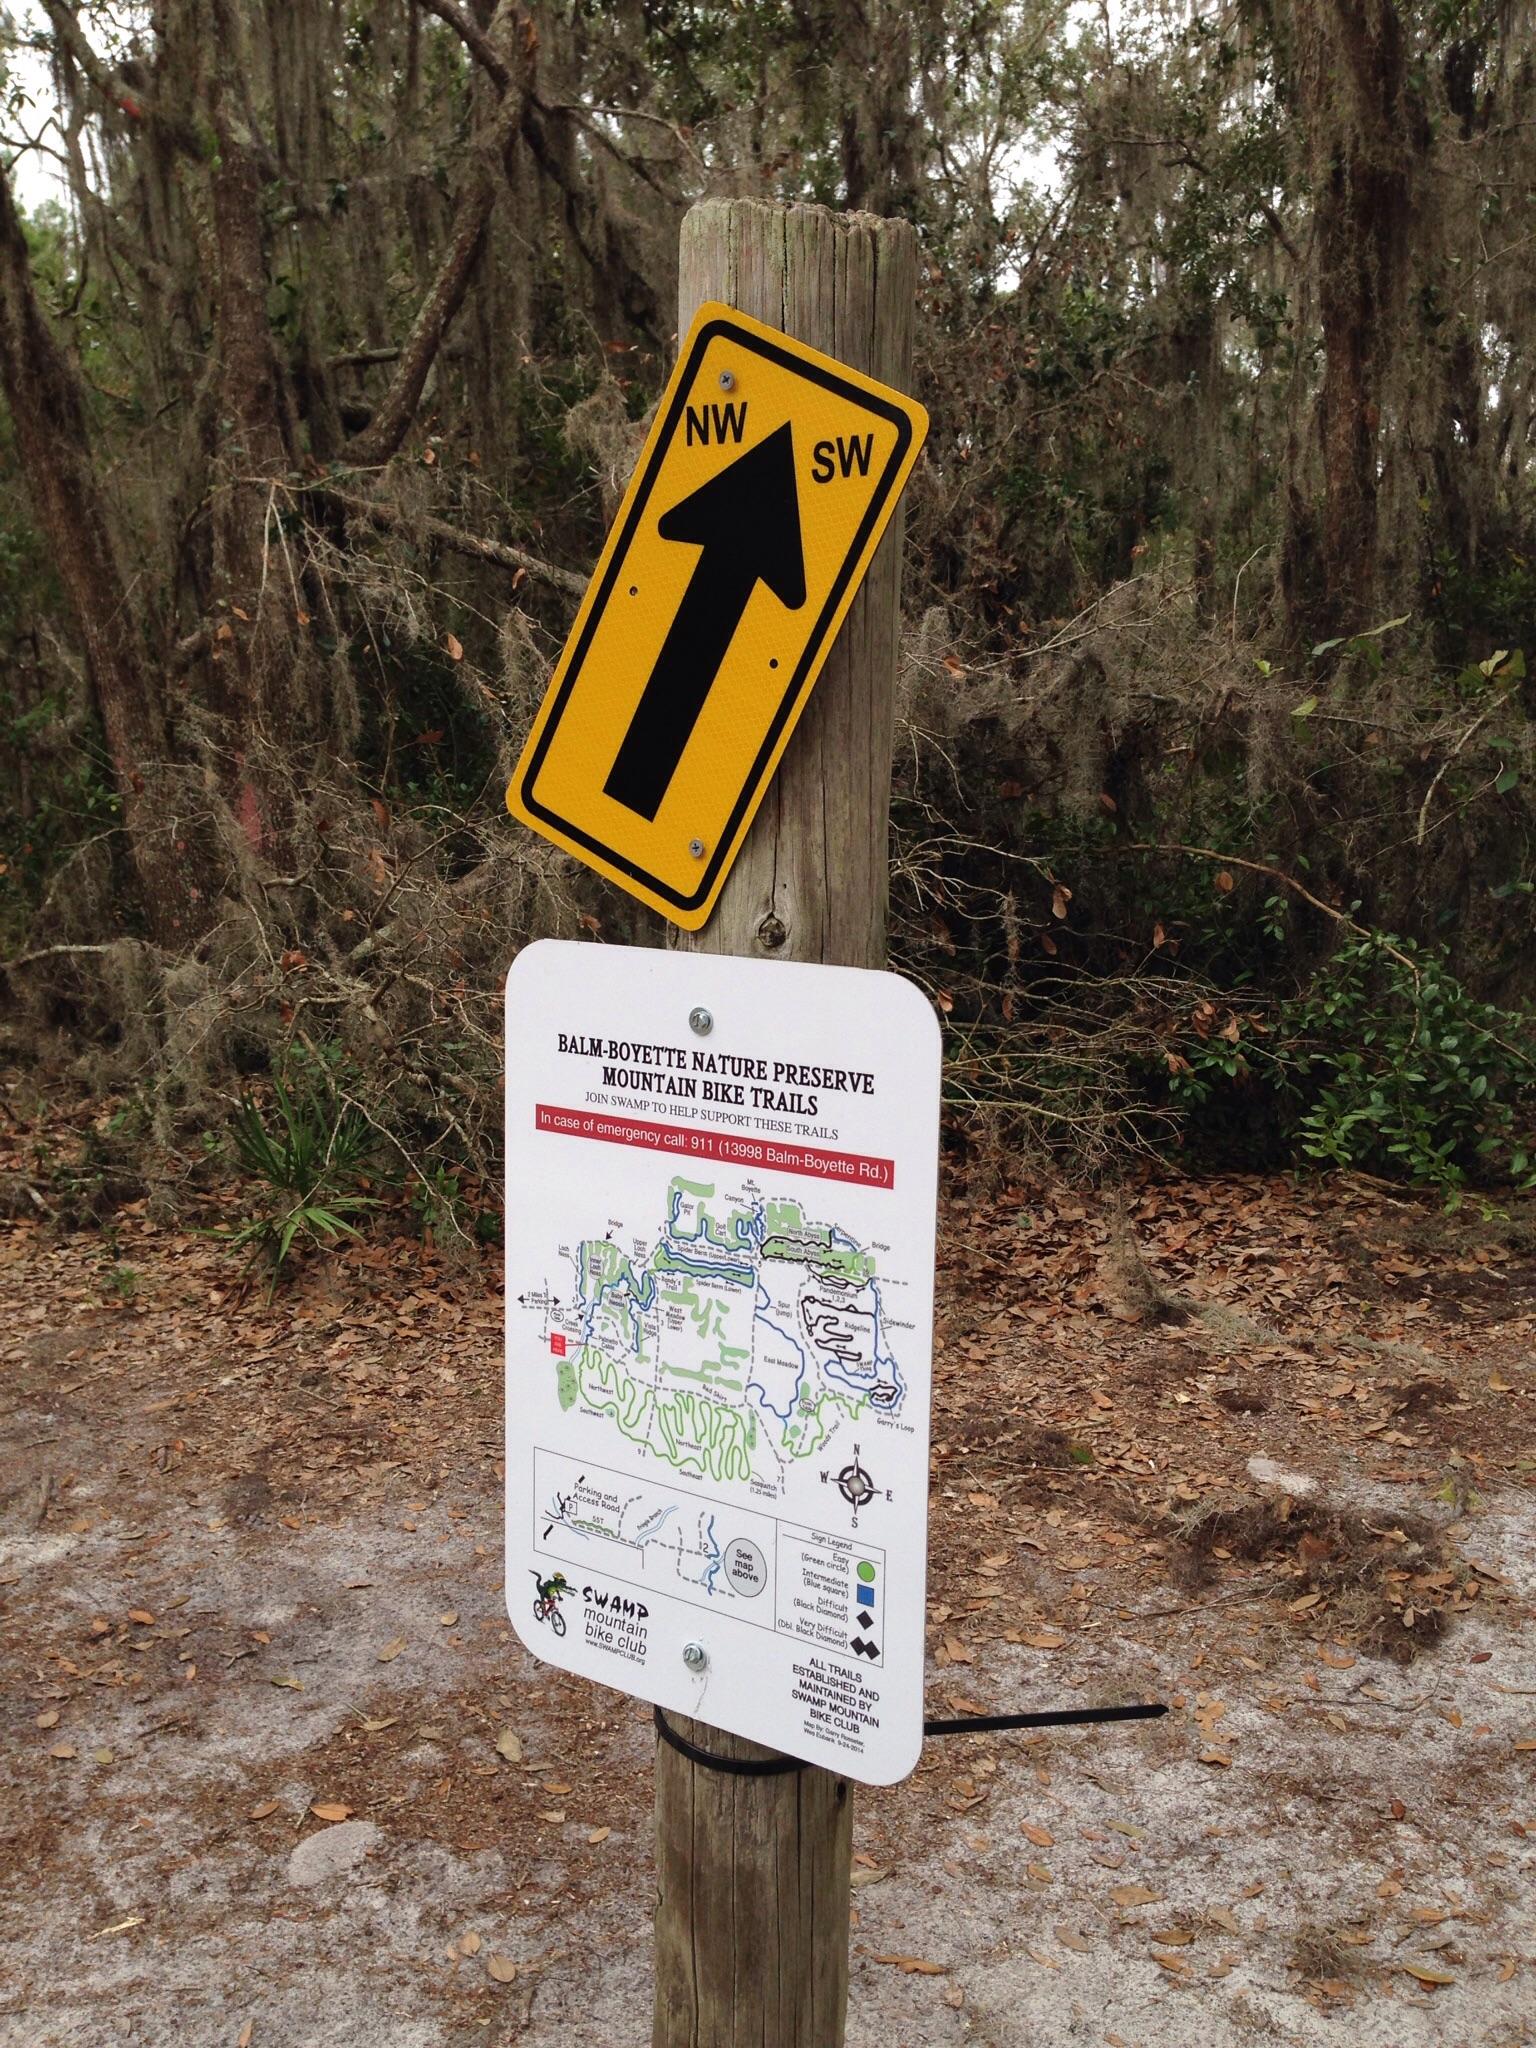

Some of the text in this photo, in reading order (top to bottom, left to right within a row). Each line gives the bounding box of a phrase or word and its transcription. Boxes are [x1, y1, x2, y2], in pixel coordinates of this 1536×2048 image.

[686, 402, 748, 446] NW
[811, 433, 874, 484] SW
[558, 1033, 874, 1095] BALM-BOYETTE NATURE PRESERVE
[603, 1066, 818, 1116] MOUNTAIN BIKE TRAILS
[585, 1091, 839, 1140] JOIN SWAMP TO HELP SUPPORT THESE TRAILS
[541, 1110, 888, 1183] In case of emergency call: 911 (13998 Balm-Boyette Rd.)
[872, 1242, 890, 1252] Bridge
[844, 1322, 871, 1333] Ridgeline
[882, 1317, 916, 1330] Sidewinder
[853, 1443, 860, 1456] N
[819, 1470, 830, 1484] W
[572, 1492, 621, 1513] Access Road
[573, 1482, 618, 1503] Parking and
[886, 1489, 893, 1502] E
[851, 1516, 858, 1529] S
[702, 1542, 709, 1554] 2
[811, 1532, 853, 1551] Sign Legend
[734, 1560, 754, 1572] map
[736, 1548, 753, 1562] See
[801, 1551, 850, 1575] (Green circle)
[832, 1552, 850, 1566] Easy
[732, 1567, 759, 1583] above
[802, 1568, 849, 1589] Intermediate
[803, 1578, 849, 1599] (Blue square)
[582, 1585, 649, 1621] SWAMP
[793, 1597, 849, 1624] (Black Diamond)
[817, 1596, 848, 1613] Difficult
[583, 1607, 648, 1639] mountain
[799, 1617, 848, 1639] Very Difficult
[585, 1621, 647, 1656] bike club
[795, 1624, 815, 1637] Black
[815, 1629, 848, 1649] Diamond)
[585, 1638, 646, 1666] www.SWAMPCLUB.org
[809, 1657, 862, 1683] ALL TRAILS
[792, 1664, 880, 1702] ESTABLISHED AND
[799, 1678, 873, 1713] MAINTAINED BY
[791, 1689, 880, 1728] SWAMP MOUNTAIN
[809, 1708, 860, 1734] BIKE CLUB
